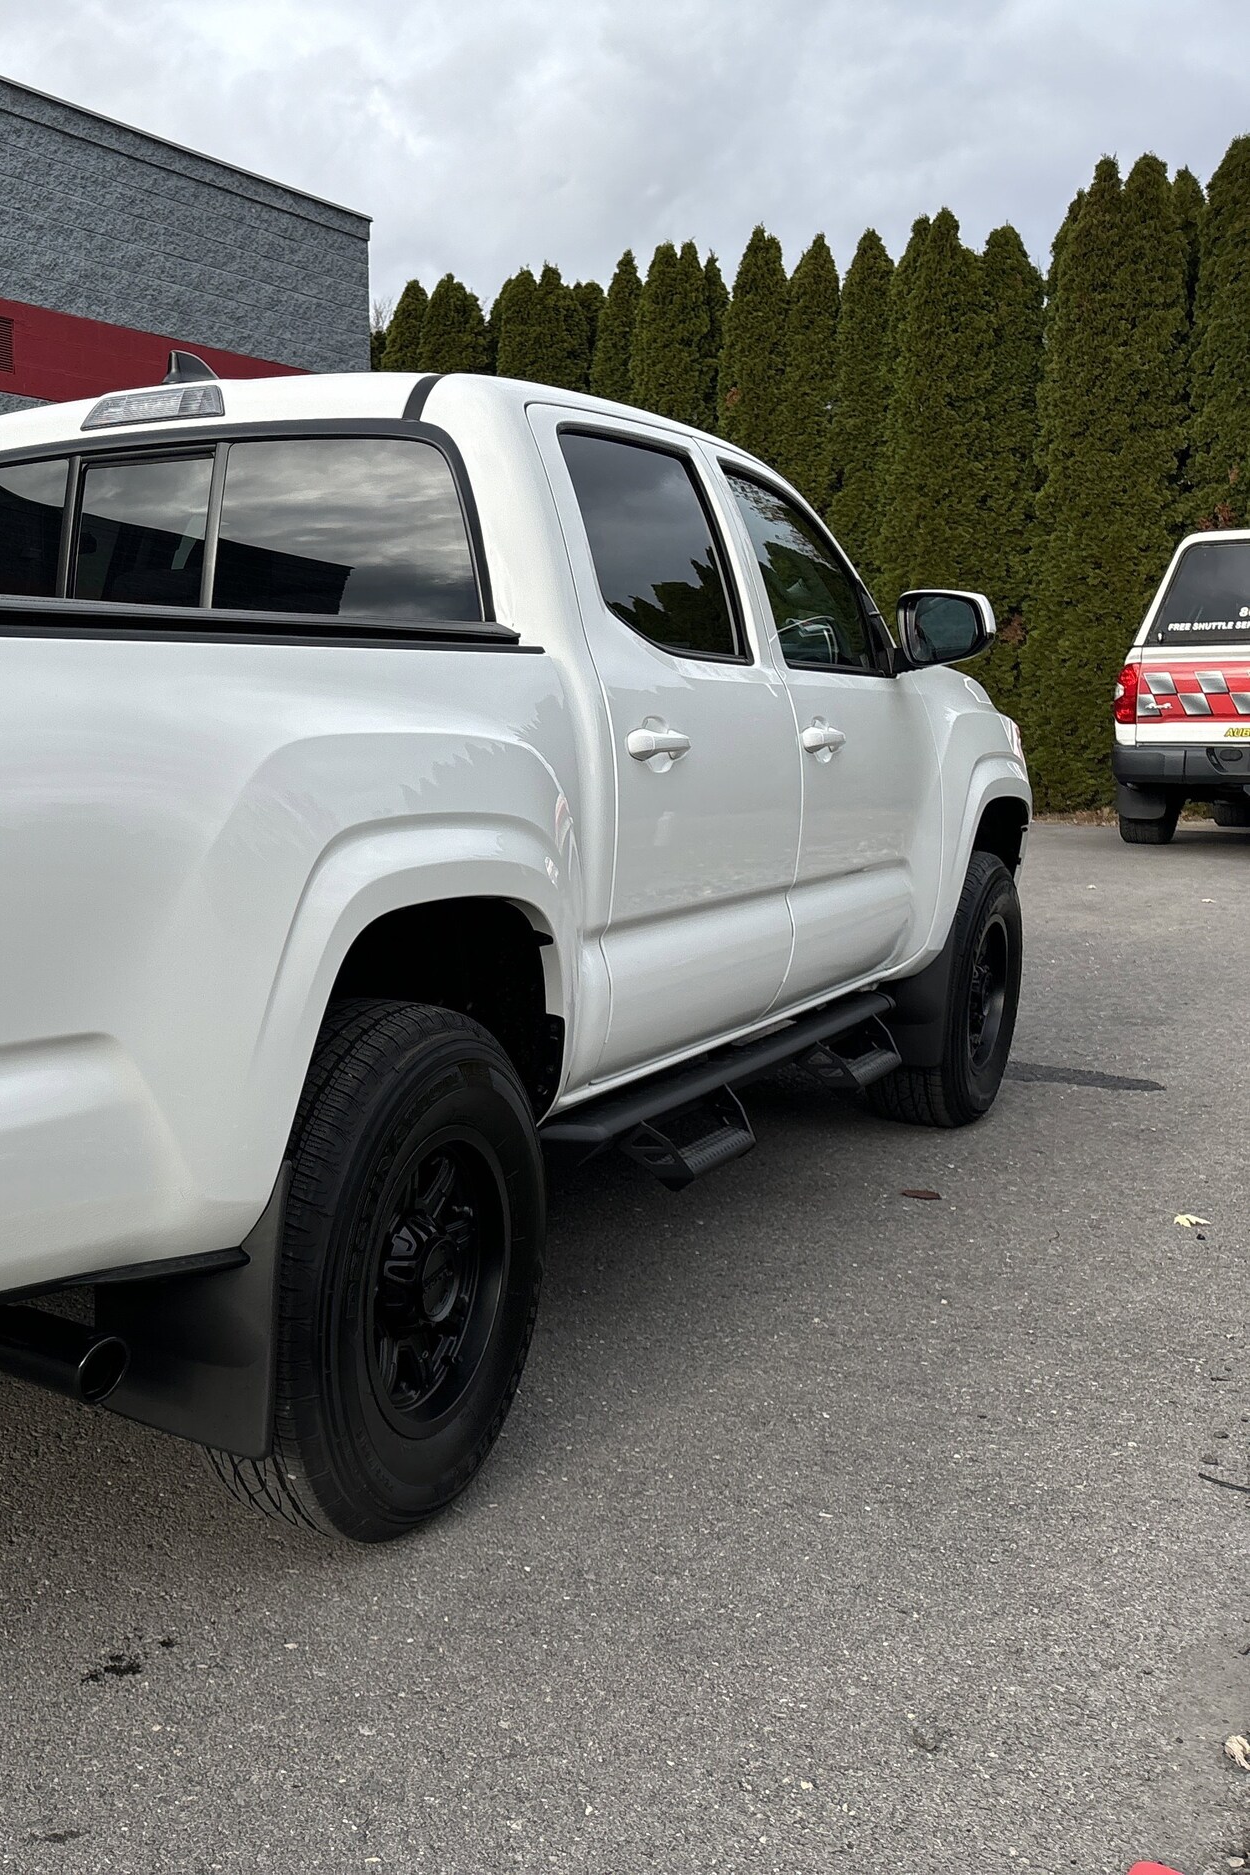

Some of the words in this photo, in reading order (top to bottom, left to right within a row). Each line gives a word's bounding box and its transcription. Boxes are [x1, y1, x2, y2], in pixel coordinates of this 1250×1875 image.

[1239, 606, 1250, 617] 8
[1168, 622, 1191, 631] FREE
[1192, 621, 1234, 631] SHUTTLE
